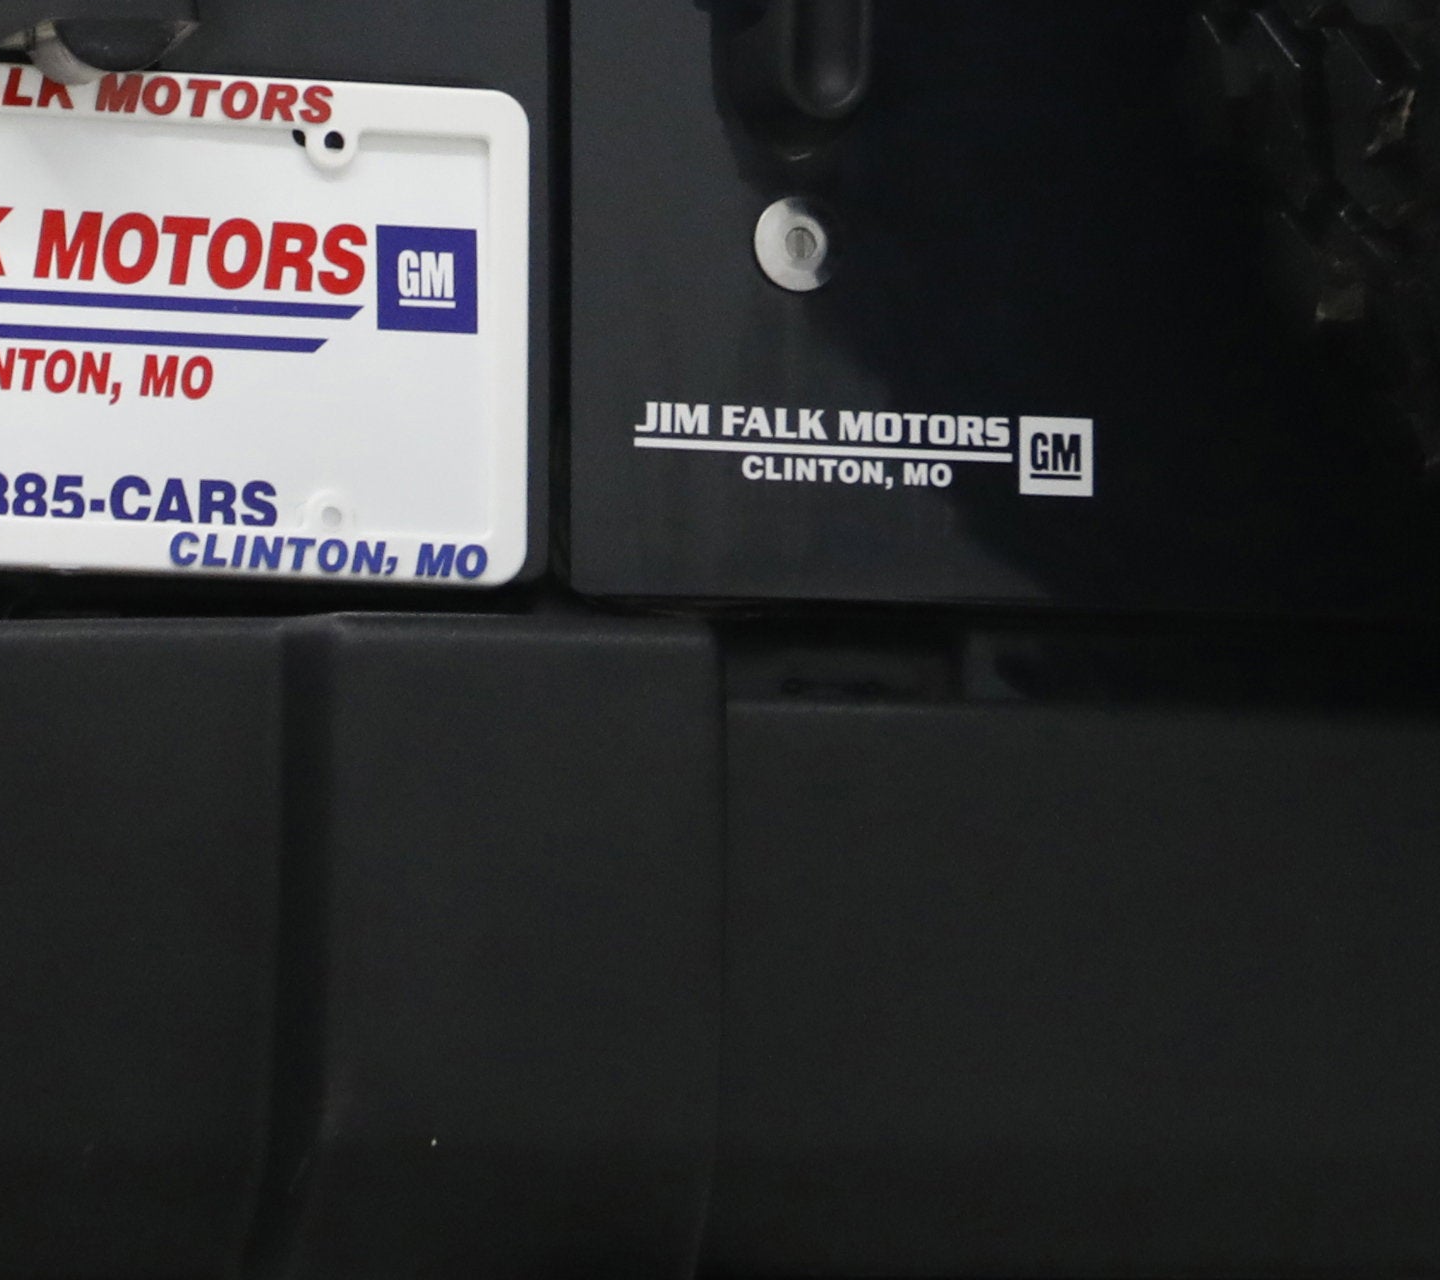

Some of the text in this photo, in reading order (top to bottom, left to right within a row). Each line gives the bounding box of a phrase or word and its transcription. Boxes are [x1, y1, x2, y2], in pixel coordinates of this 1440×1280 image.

[97, 74, 333, 124] MOTORS
[34, 209, 368, 295] MOTORS
[397, 248, 455, 298] GM
[140, 354, 214, 400] MO
[634, 401, 1010, 447] JIM FALK MOTORS
[741, 455, 953, 489] CLINTON, MO
[1030, 432, 1081, 472] GM
[169, 532, 487, 579] CLINTON, MO
